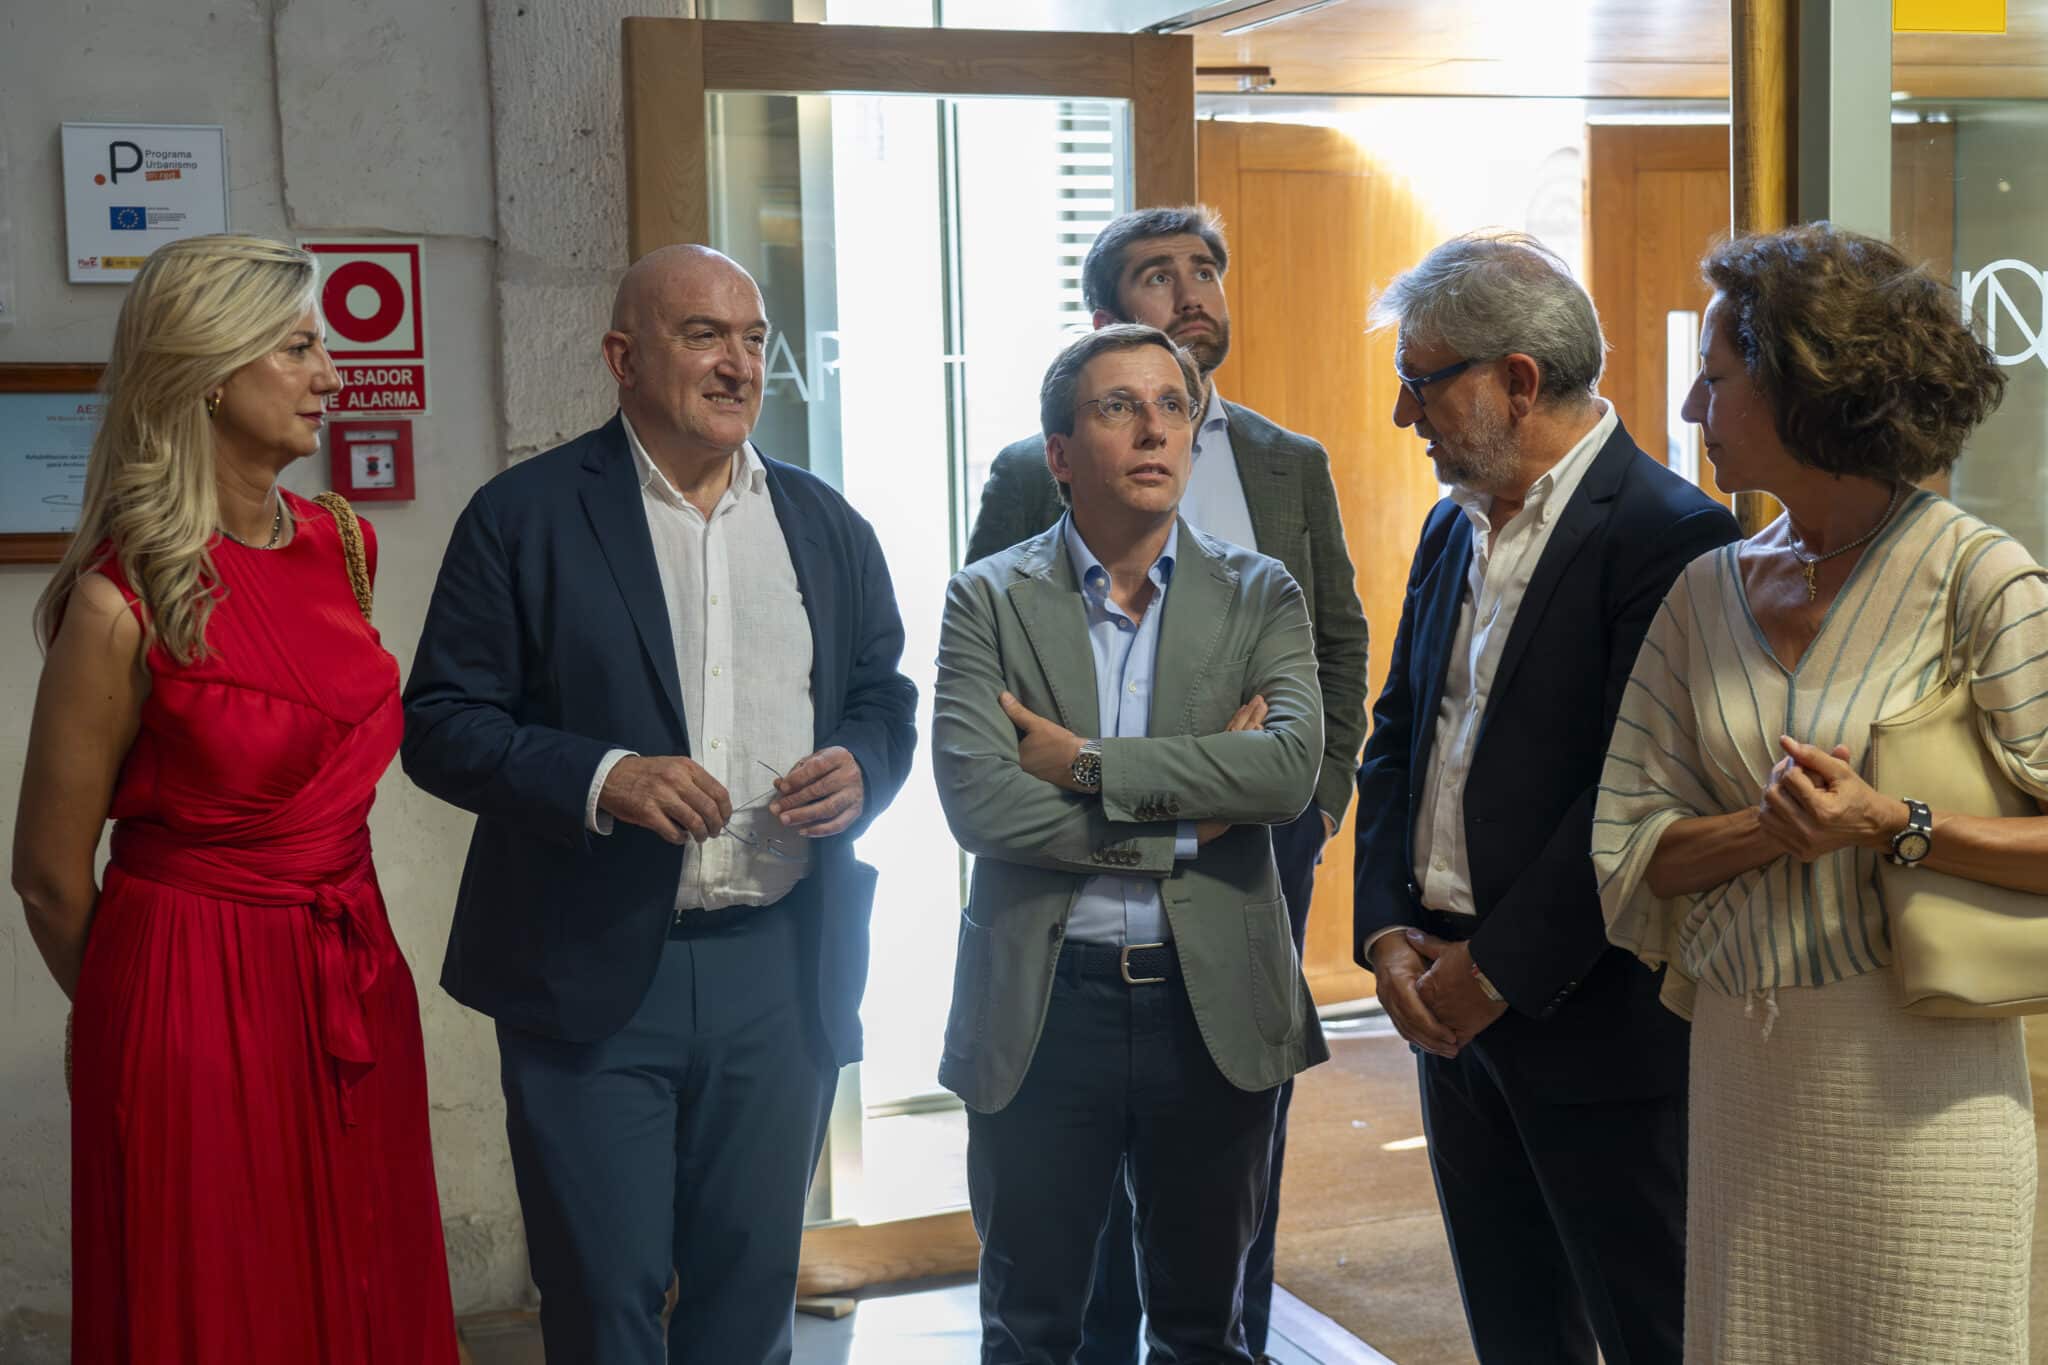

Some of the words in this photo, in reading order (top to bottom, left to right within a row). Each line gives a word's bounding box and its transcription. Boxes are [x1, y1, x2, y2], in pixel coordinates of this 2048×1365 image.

[145, 149, 192, 159] Programa
[145, 161, 198, 169] Urbanismo
[347, 391, 420, 407] ALARMA
